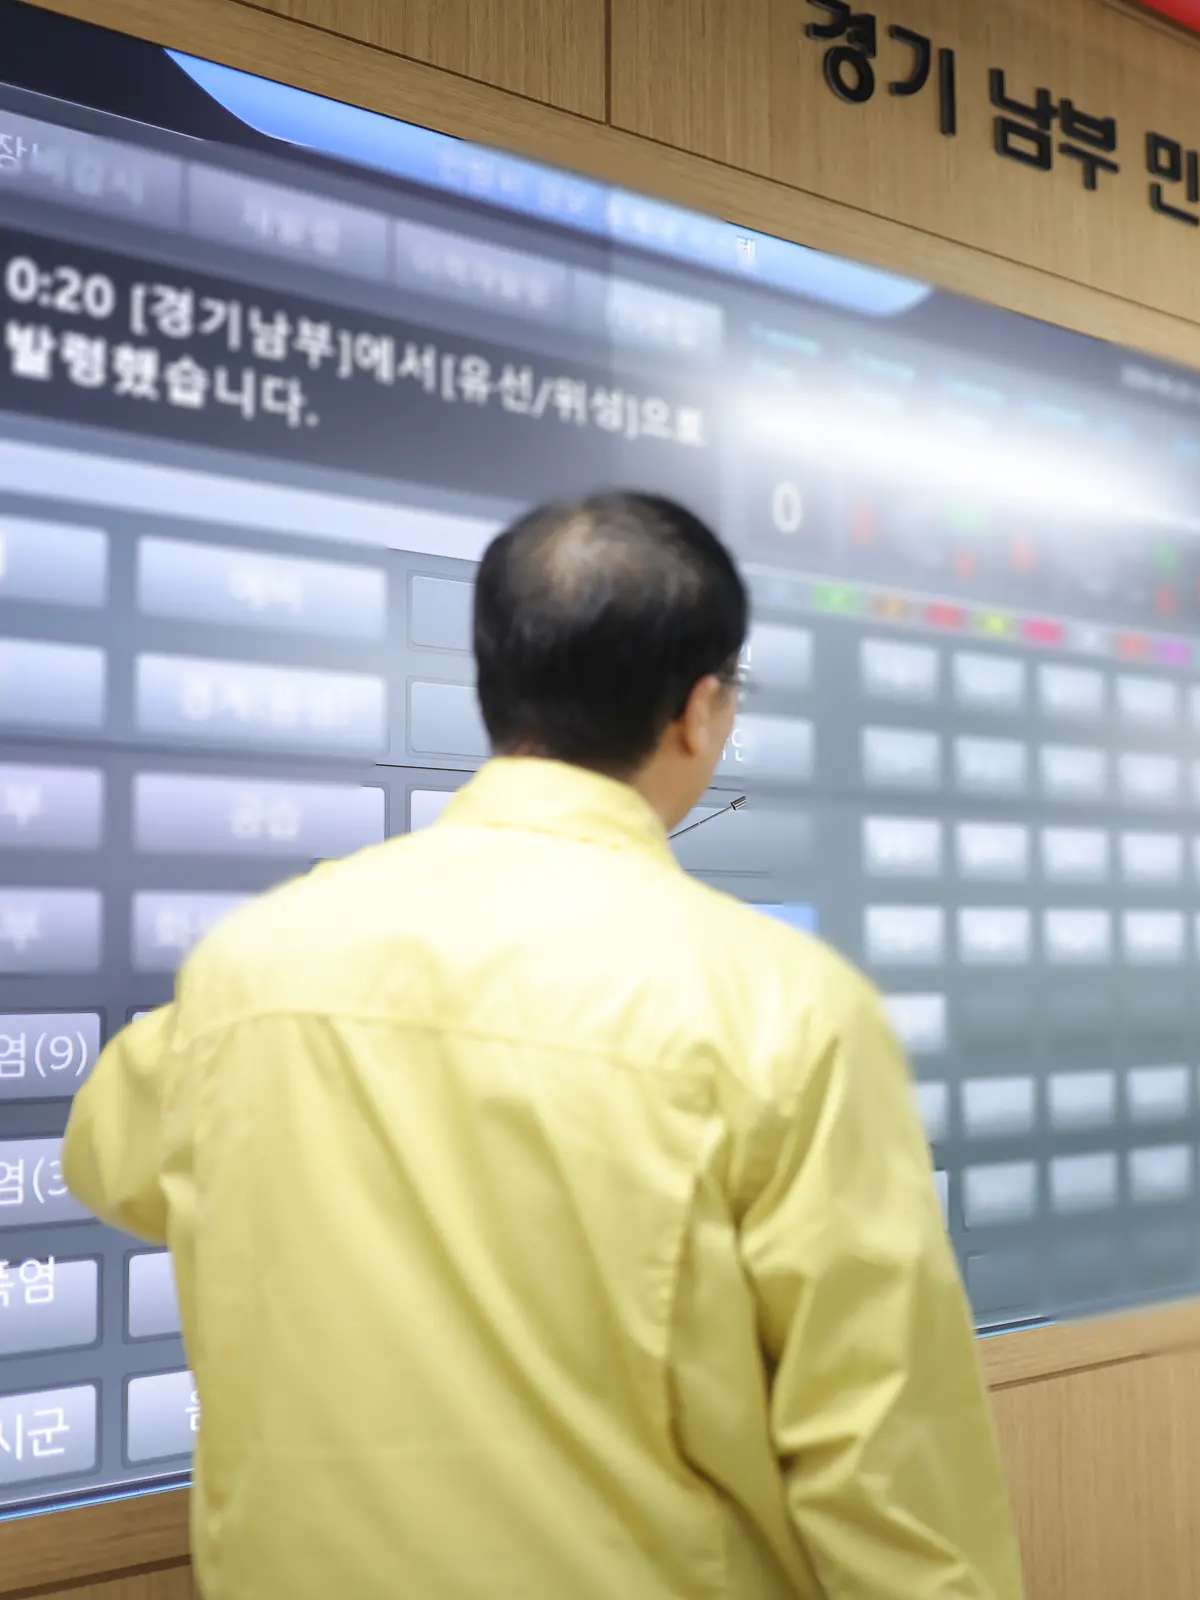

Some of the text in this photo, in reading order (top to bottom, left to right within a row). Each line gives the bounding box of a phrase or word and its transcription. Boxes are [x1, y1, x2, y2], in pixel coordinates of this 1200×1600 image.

[804, 0, 957, 137] 경기
[988, 67, 1120, 191] 남부
[5, 256, 116, 320] 0:20
[5, 320, 320, 429] 발령했습니다.
[0, 1032, 88, 1079] 염(9)
[0, 1157, 69, 1205] 염(3
